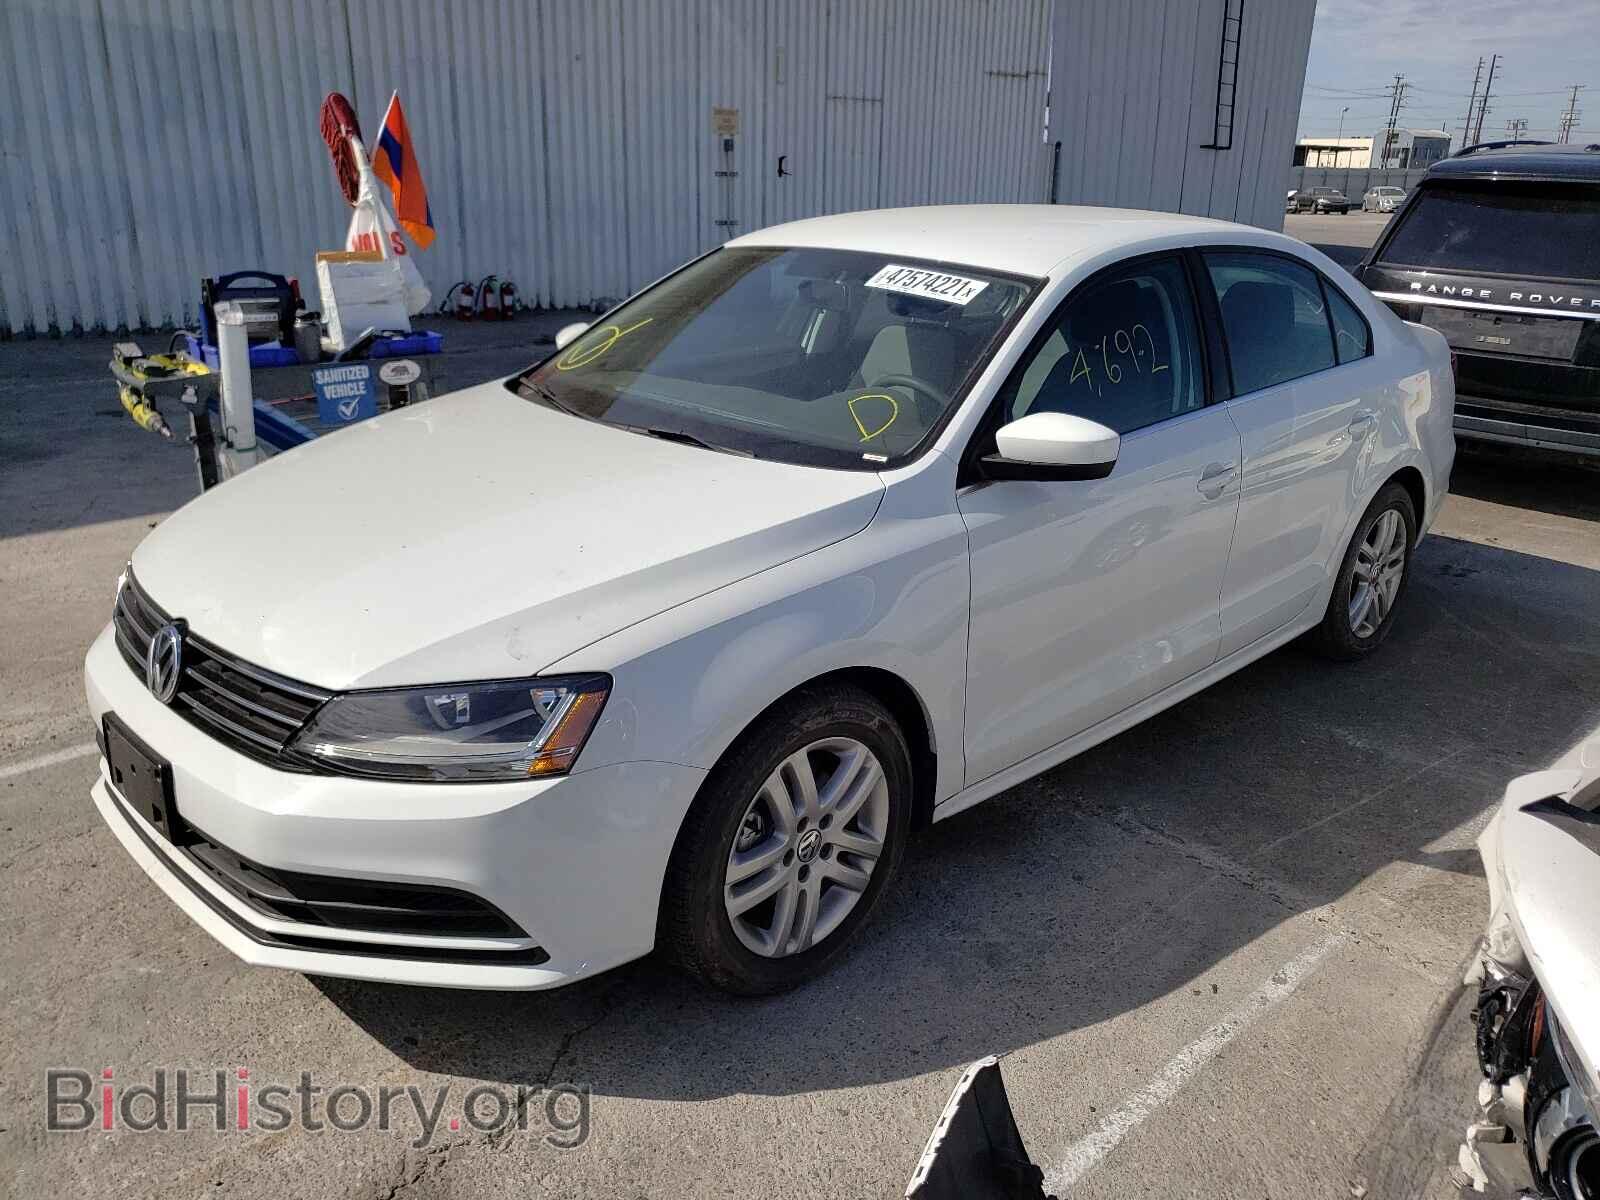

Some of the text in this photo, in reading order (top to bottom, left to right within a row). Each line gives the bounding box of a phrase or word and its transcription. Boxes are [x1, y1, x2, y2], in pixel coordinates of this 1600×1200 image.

[1410, 282, 1600, 308] RANGE ROVER
[315, 365, 369, 385] SANITIZED
[323, 381, 367, 400] VEHICLE
[848, 395, 898, 443] D
